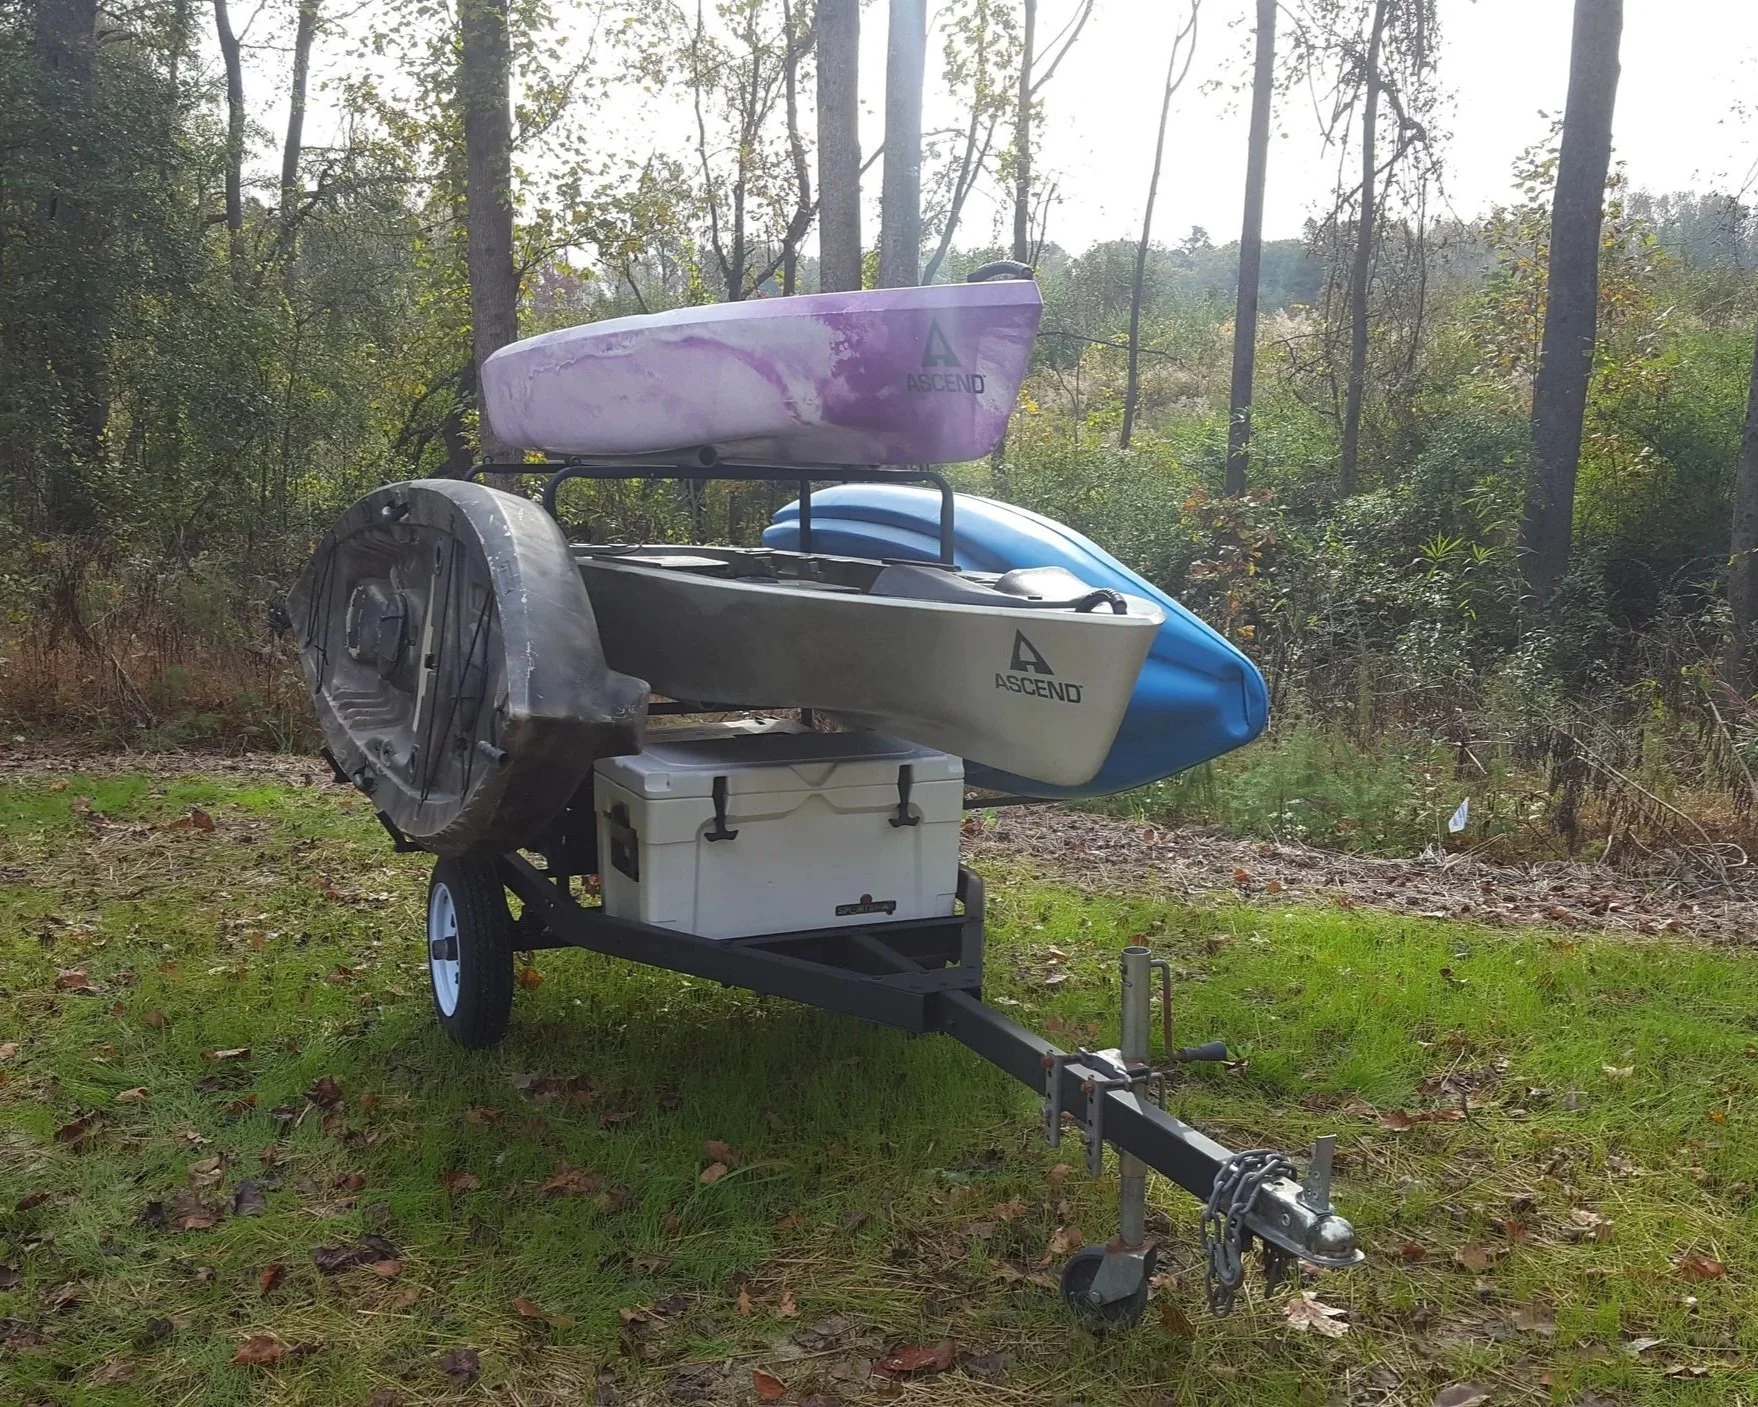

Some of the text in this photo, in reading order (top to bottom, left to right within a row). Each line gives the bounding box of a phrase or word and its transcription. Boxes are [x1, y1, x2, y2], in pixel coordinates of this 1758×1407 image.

[922, 318, 962, 367] A
[907, 373, 985, 394] ASCEND
[1010, 629, 1055, 675] A
[995, 673, 1082, 703] ASCEND
